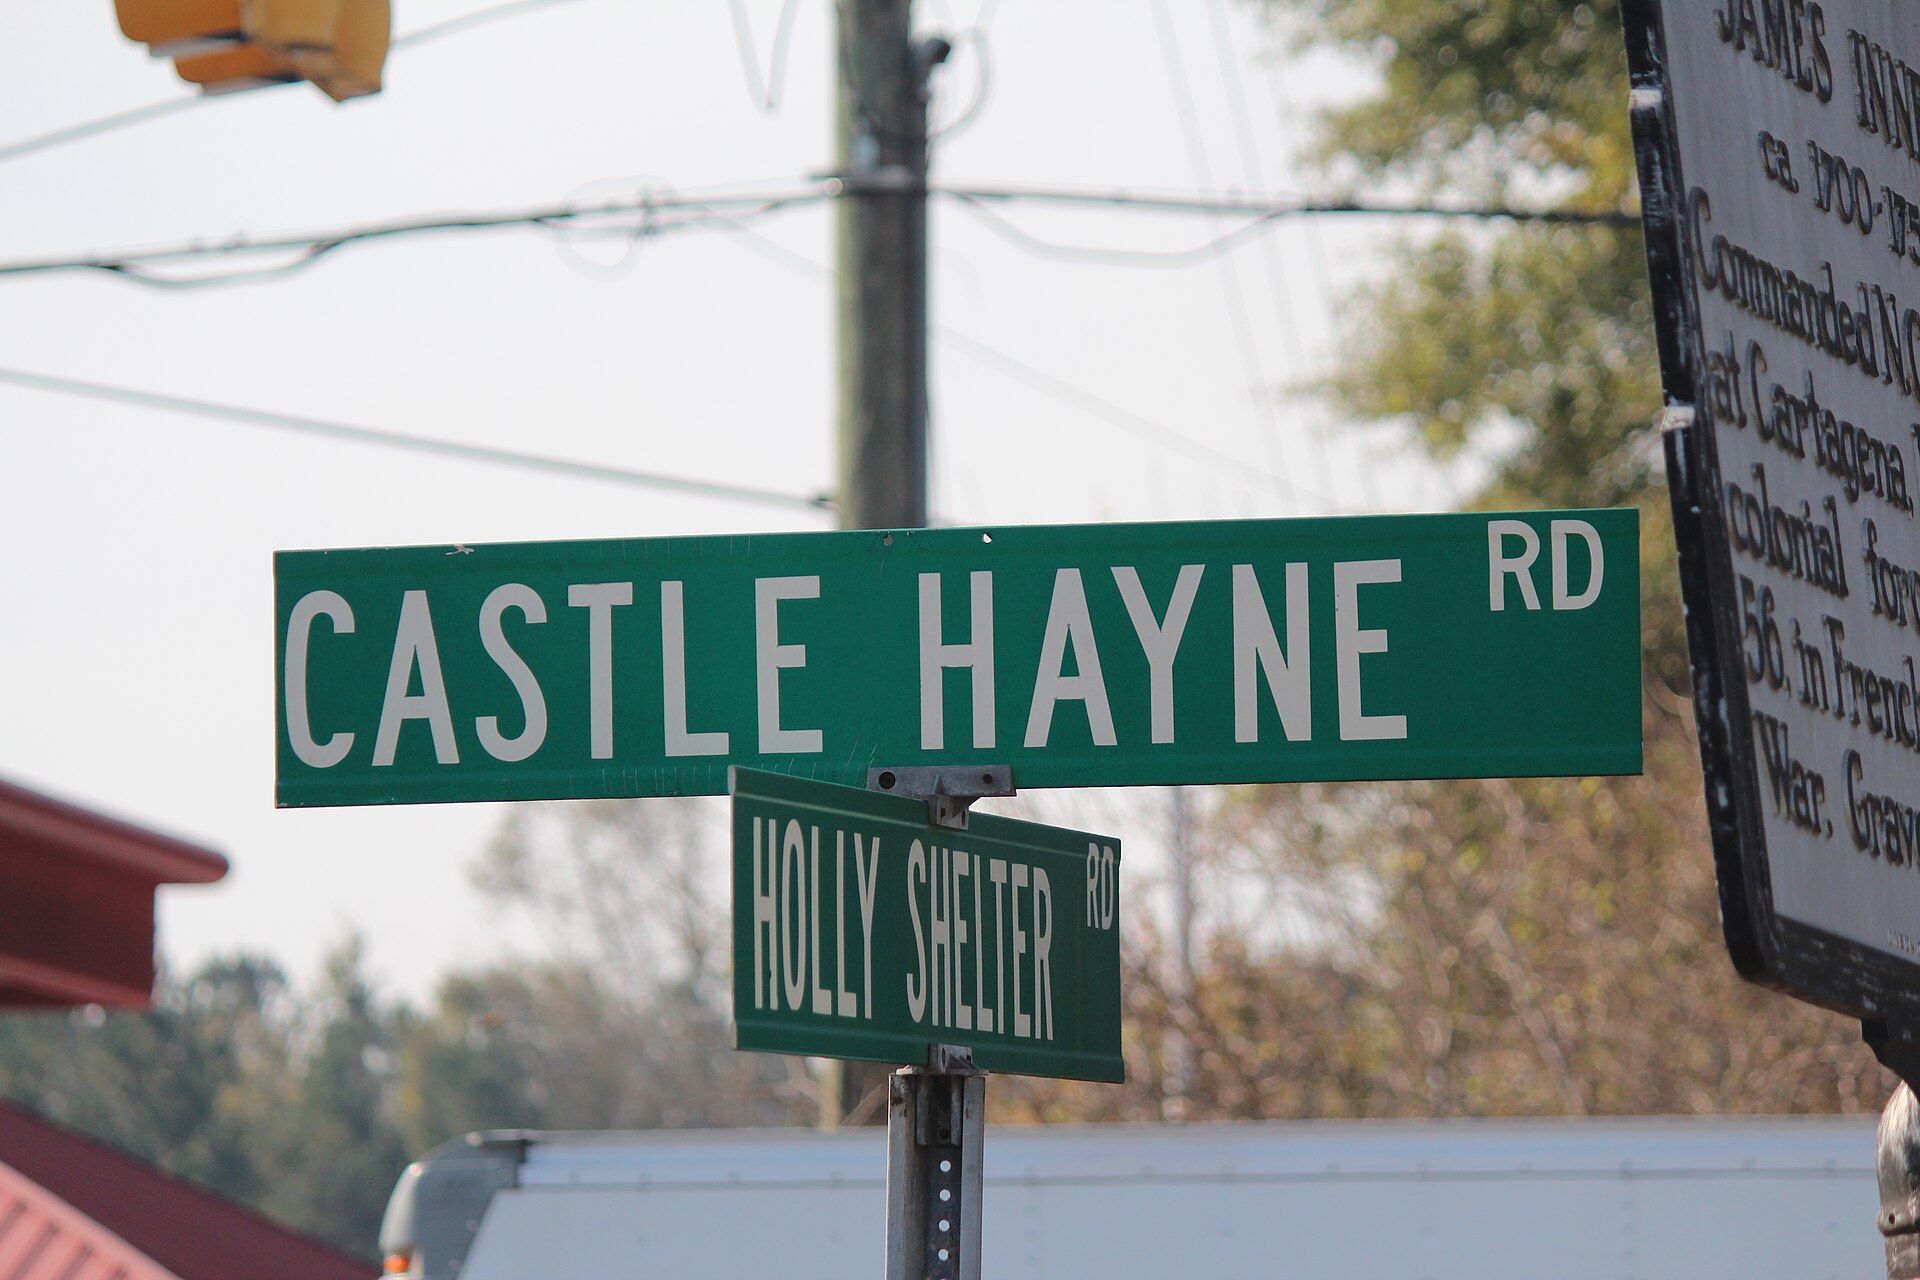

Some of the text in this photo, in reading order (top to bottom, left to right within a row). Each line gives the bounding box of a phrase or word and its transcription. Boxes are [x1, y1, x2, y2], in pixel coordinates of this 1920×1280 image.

[1757, 130, 1799, 194] ca.
[1688, 185, 1880, 378] Commanded
[1706, 328, 1748, 430] at
[1745, 338, 1914, 521] Cartagena,
[1724, 462, 1850, 598] colonial
[285, 519, 1605, 768] CASTLE HAYNE RD
[1789, 617, 1829, 712] in
[1751, 709, 1833, 838] War.
[753, 816, 1114, 1041] HOLLY SHELTER RD
